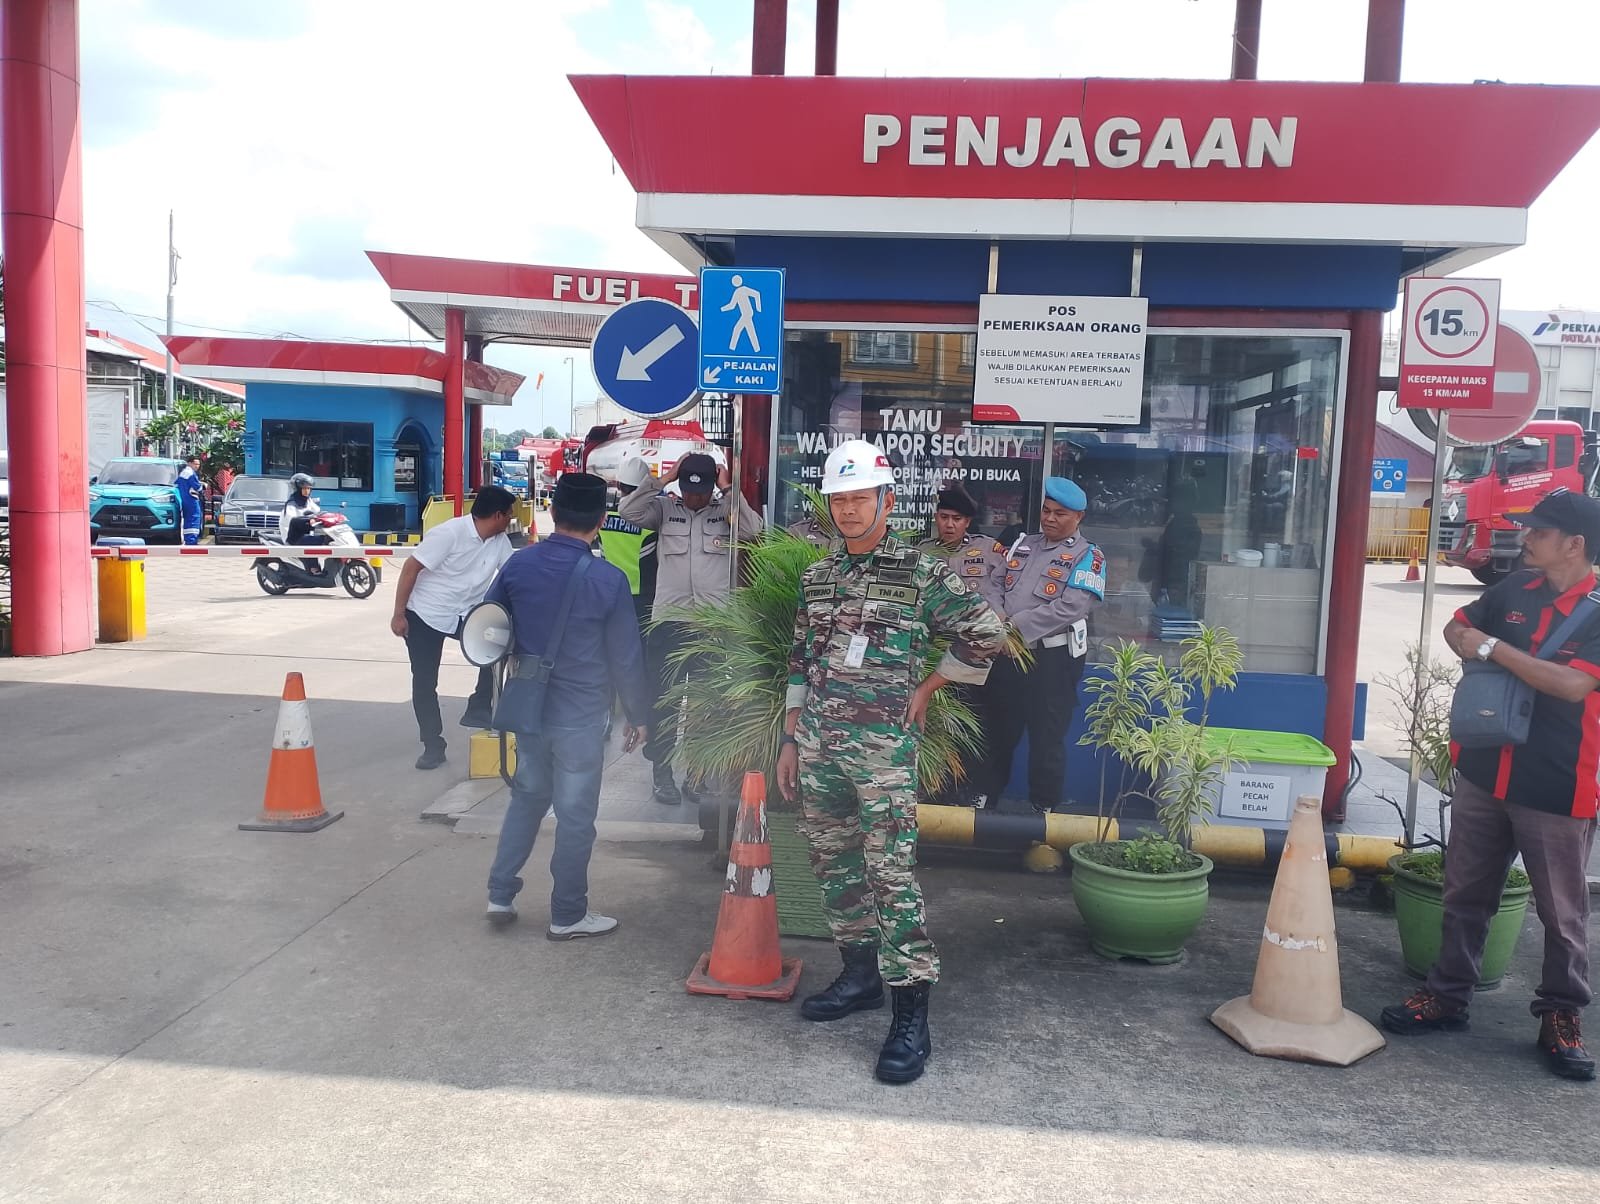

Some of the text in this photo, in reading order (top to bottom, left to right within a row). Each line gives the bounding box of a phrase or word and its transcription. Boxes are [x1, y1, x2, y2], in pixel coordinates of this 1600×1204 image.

[863, 113, 1298, 169] PENJAGAAN
[1048, 306, 1077, 316] POS
[983, 320, 1142, 334] PEMERIKSAAN ORANG
[1423, 308, 1479, 337] 15 km
[1562, 323, 1600, 333] PERTA
[980, 349, 1142, 361] SEBELUM MEMASUKI AREA TERBATAS
[723, 361, 776, 372] PEJALAN
[988, 363, 1131, 374] WAJIB DILAKUKAN PEMERIKSAAN
[735, 375, 764, 385] KAKI
[994, 376, 1123, 388] SESUAI KETENTUAN BERLAKU
[1407, 375, 1487, 386] KECEPATAN MAKS
[1423, 388, 1470, 398] 15 KM/JAM
[879, 409, 942, 432] TAMU
[930, 433, 1025, 458] SECURITY
[891, 467, 921, 481] OBIL
[924, 468, 968, 481] HARAP
[970, 469, 983, 481] DI
[986, 469, 1021, 482] BUKA
[601, 517, 641, 534] SATPAM
[964, 558, 984, 566] POLRI
[1050, 559, 1073, 569] POLRI
[878, 588, 906, 599] TNI AD
[1240, 780, 1275, 790] BARANG
[1242, 792, 1270, 801] PECAH
[1241, 803, 1268, 812] BELAH
